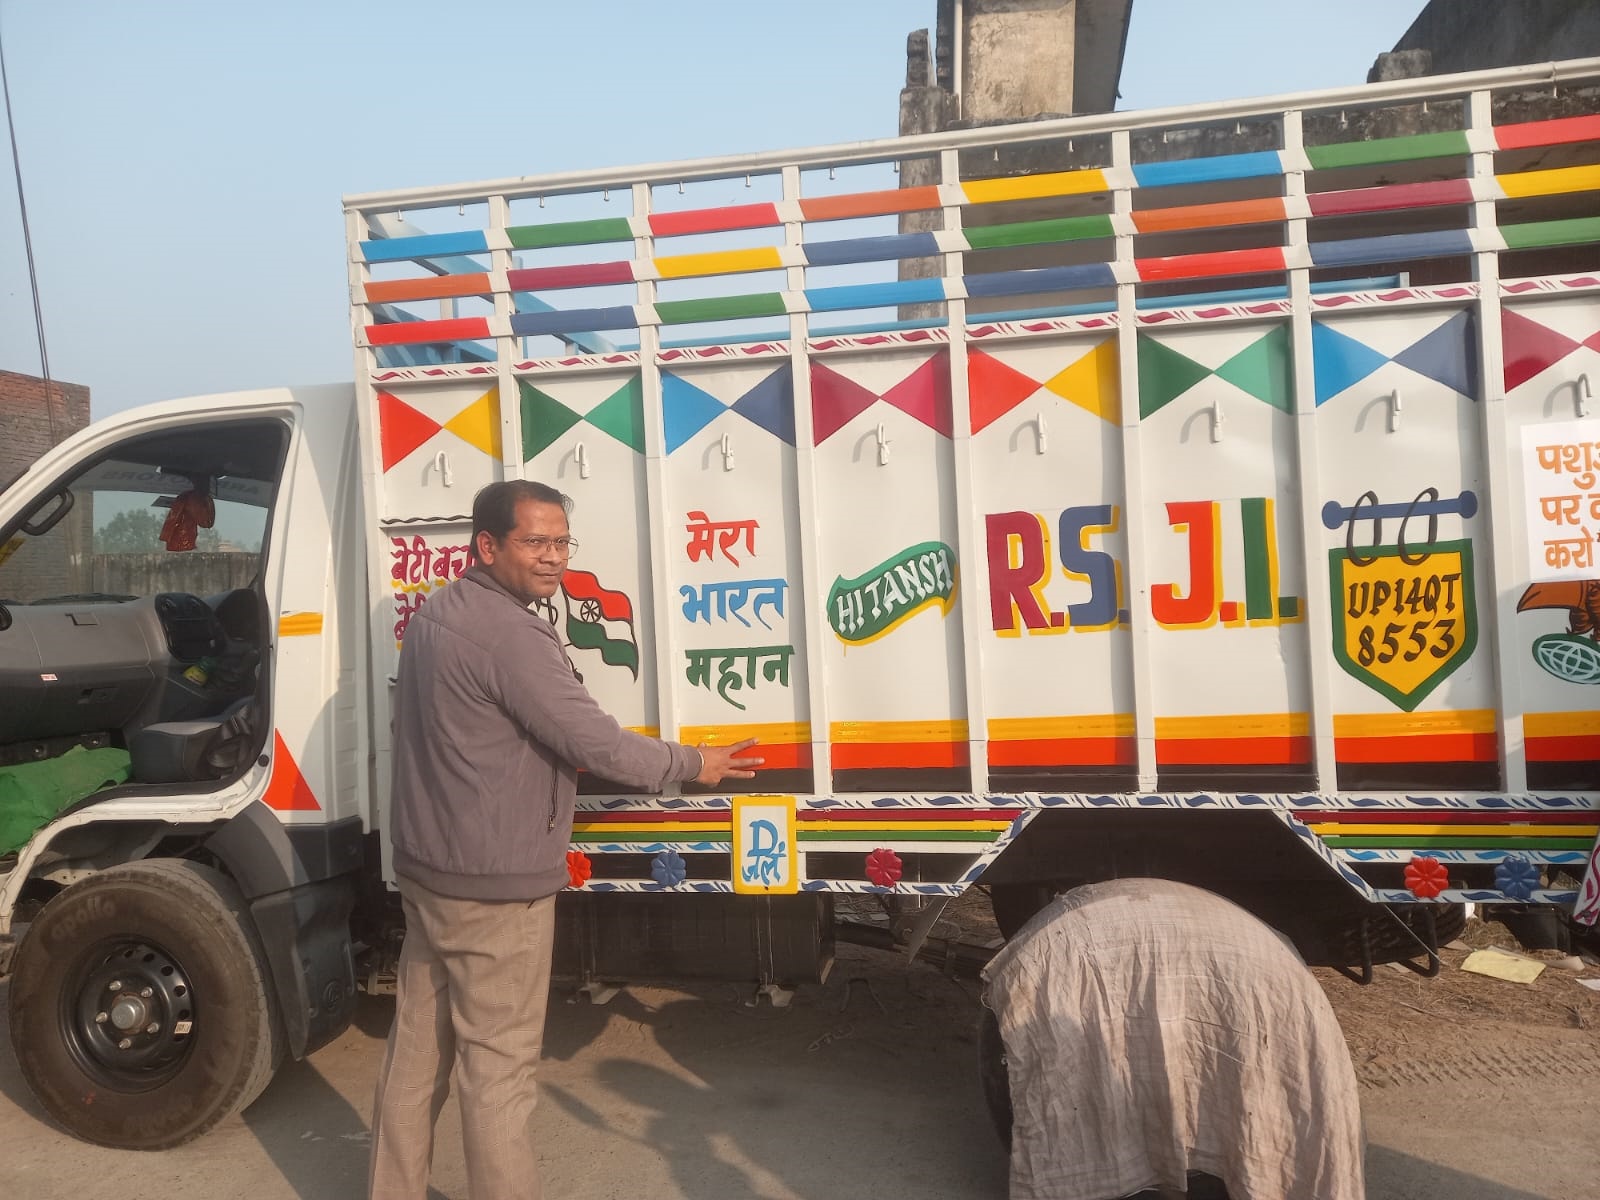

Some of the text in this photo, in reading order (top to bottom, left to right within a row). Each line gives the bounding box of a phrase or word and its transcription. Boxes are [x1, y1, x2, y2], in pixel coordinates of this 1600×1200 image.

[1540, 494, 1582, 526] पर
[390, 535, 433, 584] बेटी
[686, 511, 760, 568] मेरा
[1544, 526, 1594, 569] करो
[679, 578, 790, 631] भारत
[835, 549, 954, 635] HITANSH
[1347, 573, 1462, 624] UP14QT
[1358, 619, 1457, 667] 8553
[685, 645, 796, 711] महान
